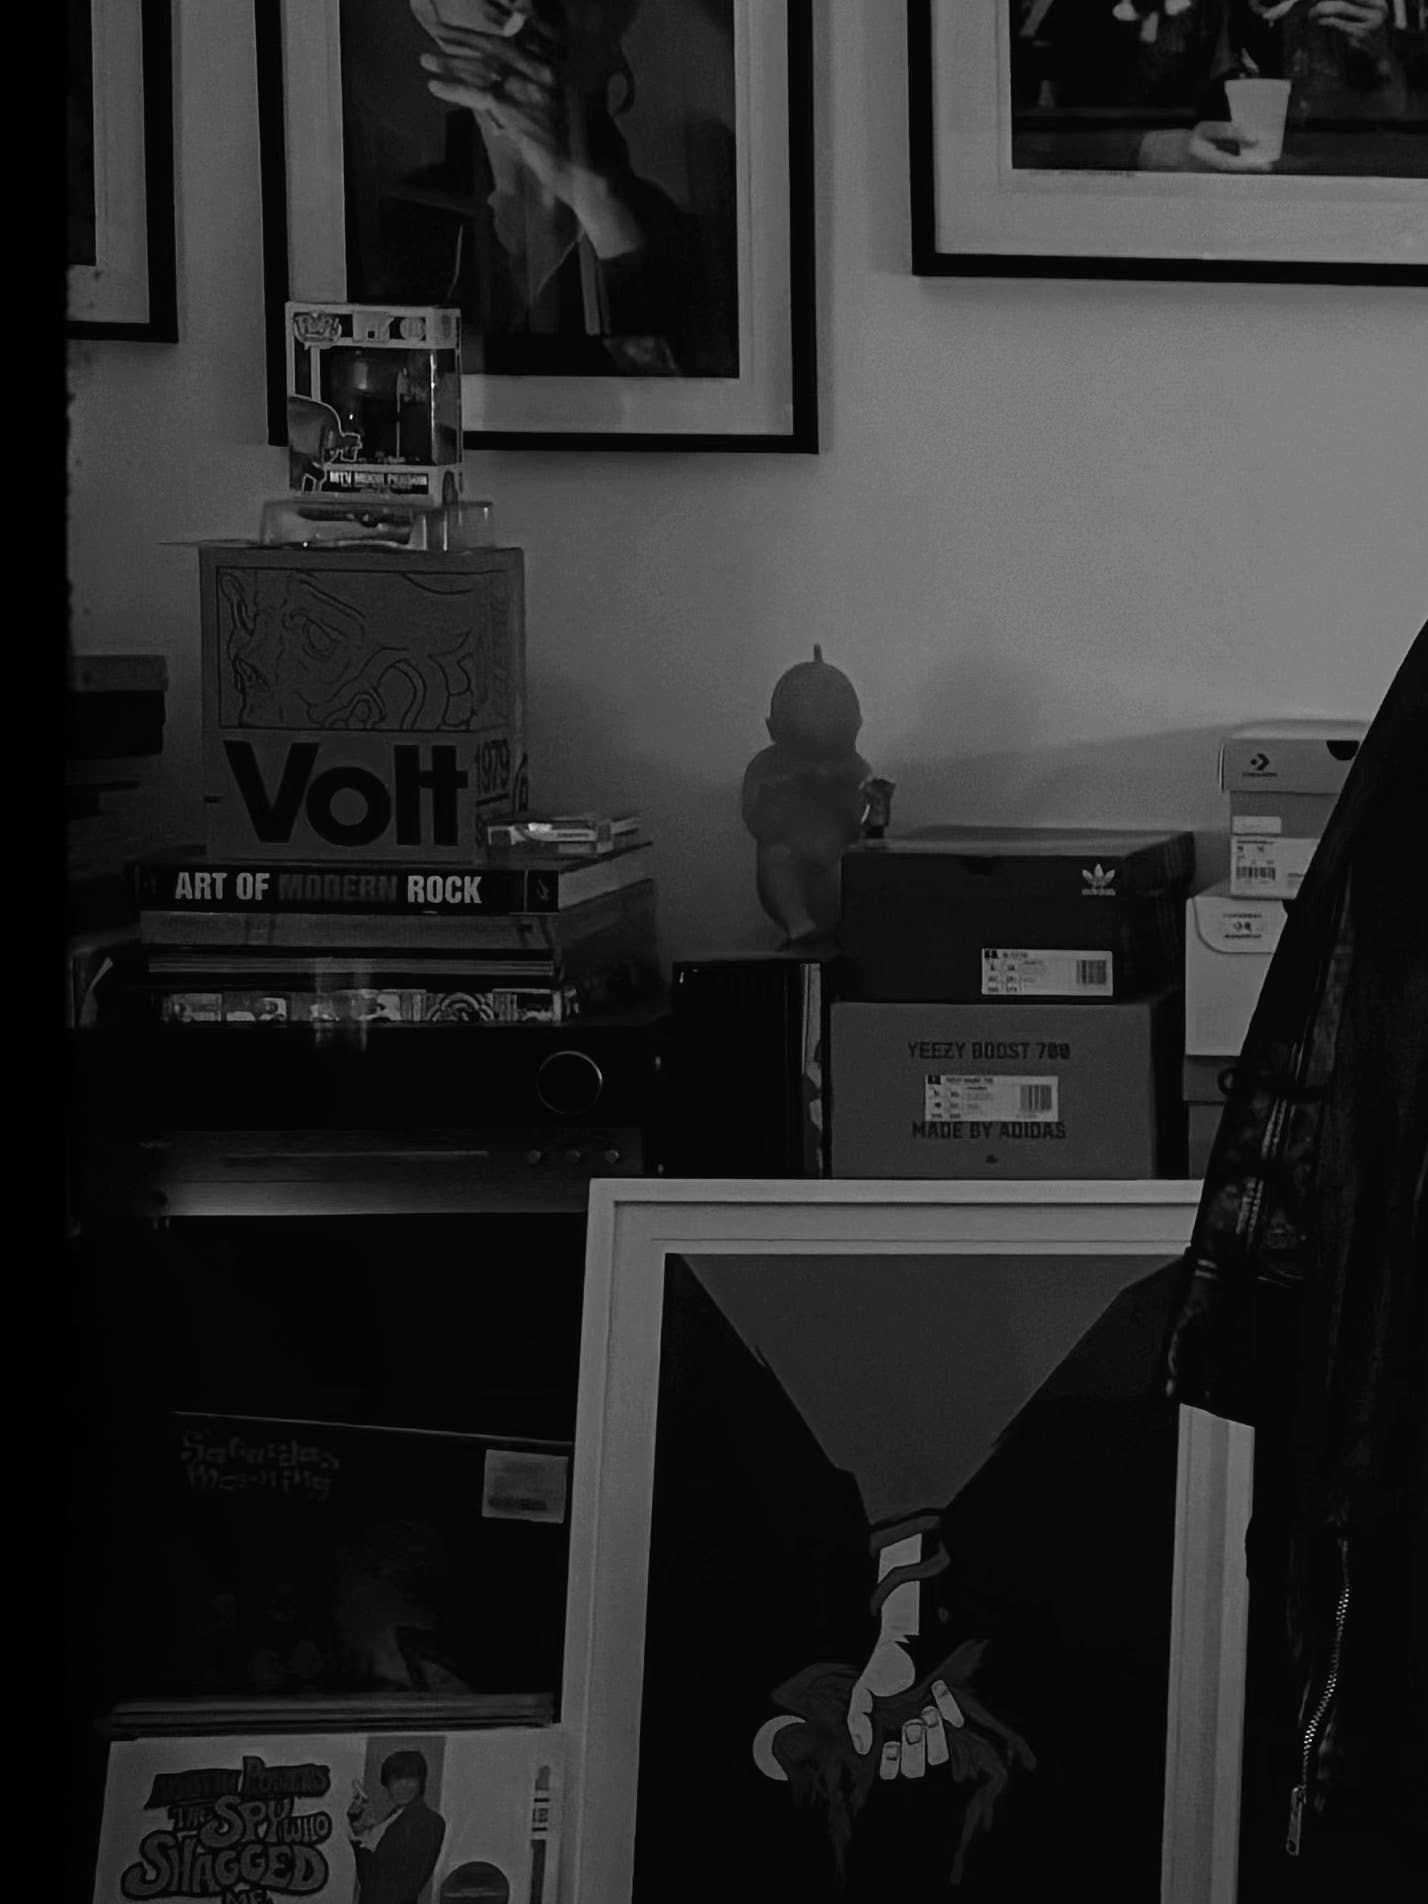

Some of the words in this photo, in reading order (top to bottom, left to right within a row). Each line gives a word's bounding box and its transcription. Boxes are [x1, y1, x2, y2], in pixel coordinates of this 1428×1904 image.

[222, 739, 468, 847] Volt
[174, 871, 228, 901] ART
[235, 872, 270, 901] OF
[278, 872, 397, 904] MODERN
[406, 874, 484, 905] ROCK
[908, 1042, 966, 1060] YEEZY
[972, 1042, 1030, 1060] BOOST
[1037, 1042, 1072, 1060] 700
[911, 1122, 963, 1139] MADE
[969, 1122, 993, 1139] BY
[999, 1122, 1067, 1139] ADIDAS
[199, 1793, 295, 1849] SPY
[280, 1811, 333, 1845] WHO
[120, 1829, 330, 1900] SHAGGED
